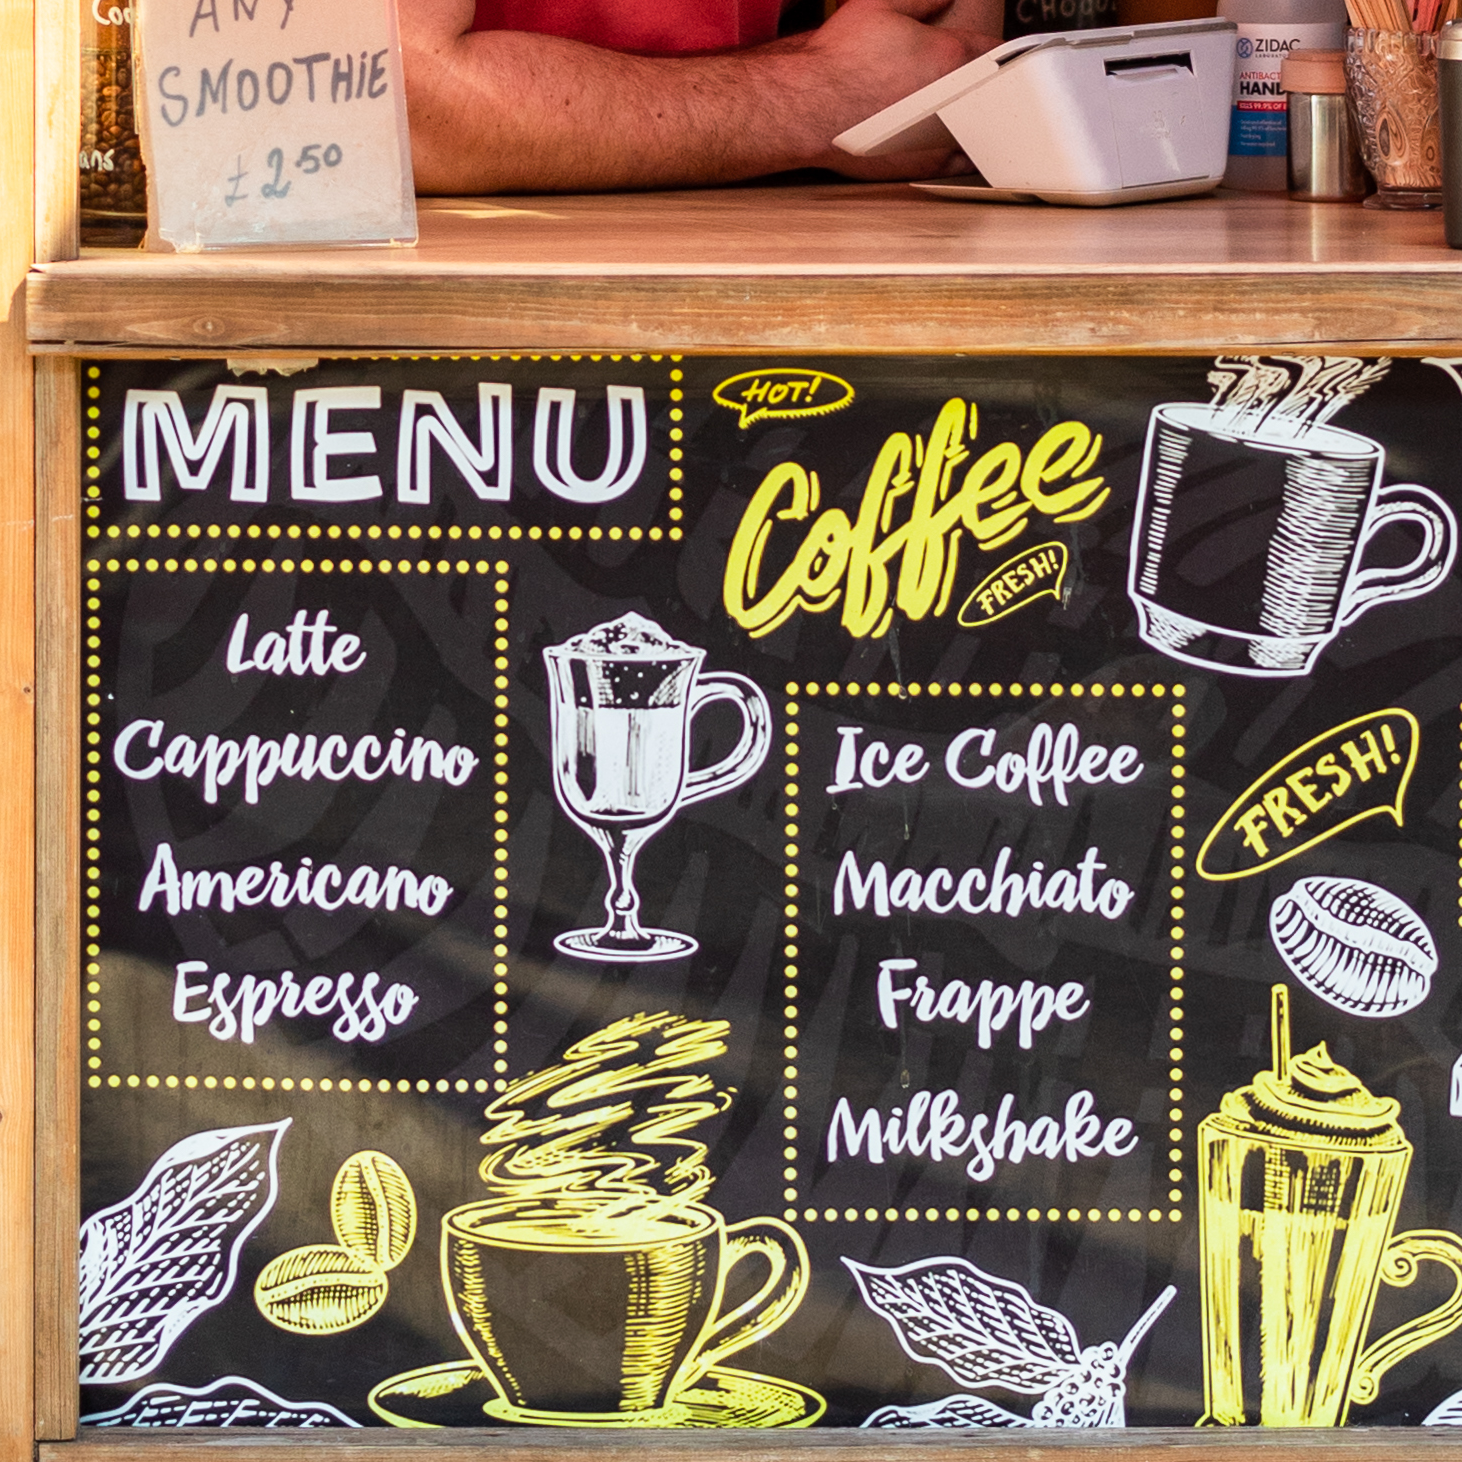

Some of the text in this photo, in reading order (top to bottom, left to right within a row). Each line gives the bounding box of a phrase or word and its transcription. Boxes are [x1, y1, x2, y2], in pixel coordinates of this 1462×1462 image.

[1254, 38, 1301, 53] ZIDAC
[739, 377, 823, 406] HOT!
[122, 381, 649, 505] MENU
[723, 394, 1111, 640] Coffee
[975, 549, 1060, 616] FRESH!
[225, 608, 367, 676] Latte
[112, 718, 480, 805] Cappuccino
[825, 723, 1146, 809] Ice Coffee
[1232, 720, 1408, 860] FRESH!
[138, 842, 455, 921] Americano
[831, 847, 1136, 922] Macchiato
[169, 959, 421, 1044] Espresso
[875, 957, 1092, 1050] Frappe
[826, 1087, 1140, 1183] Milkshake
